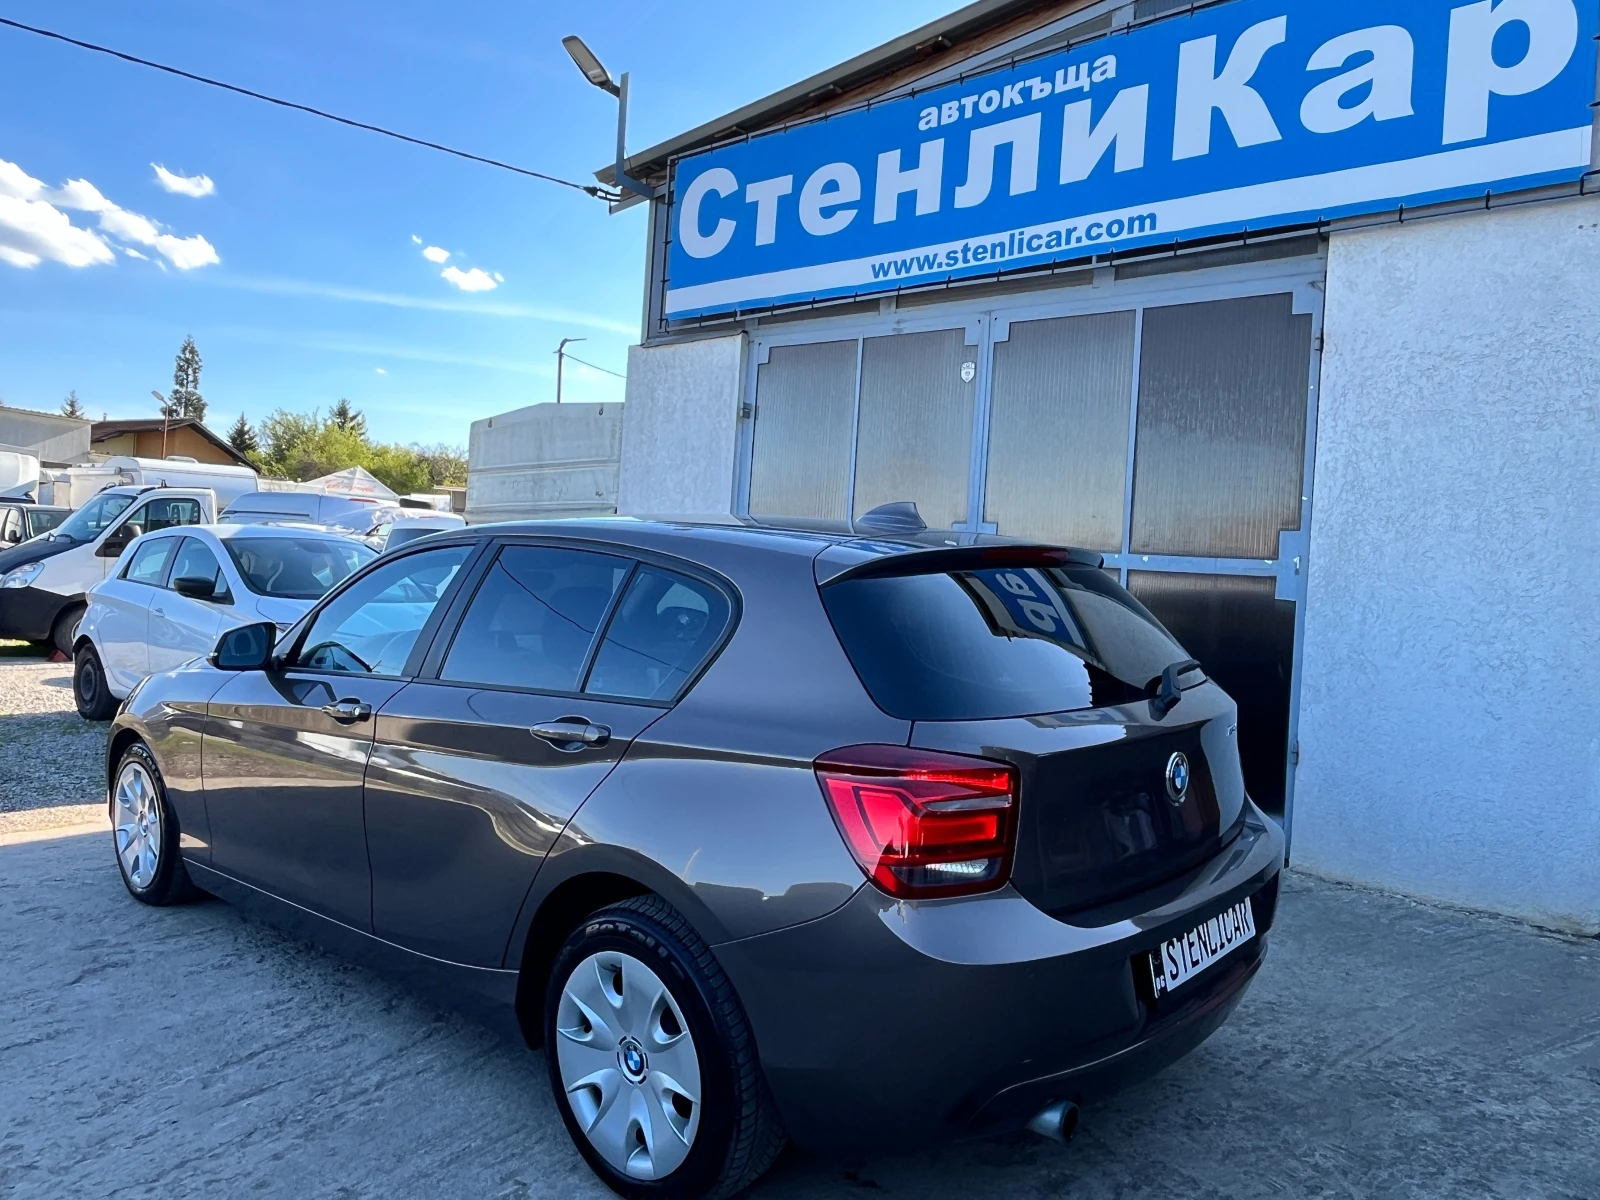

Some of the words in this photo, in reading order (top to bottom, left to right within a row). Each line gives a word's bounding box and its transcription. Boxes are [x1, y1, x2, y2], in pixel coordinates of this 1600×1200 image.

[679, 0, 1578, 259] СтенлиКар
[918, 54, 1116, 131] автокъща
[870, 208, 1157, 280] www.stenlicar.com
[1166, 900, 1251, 981] STENLICAR
